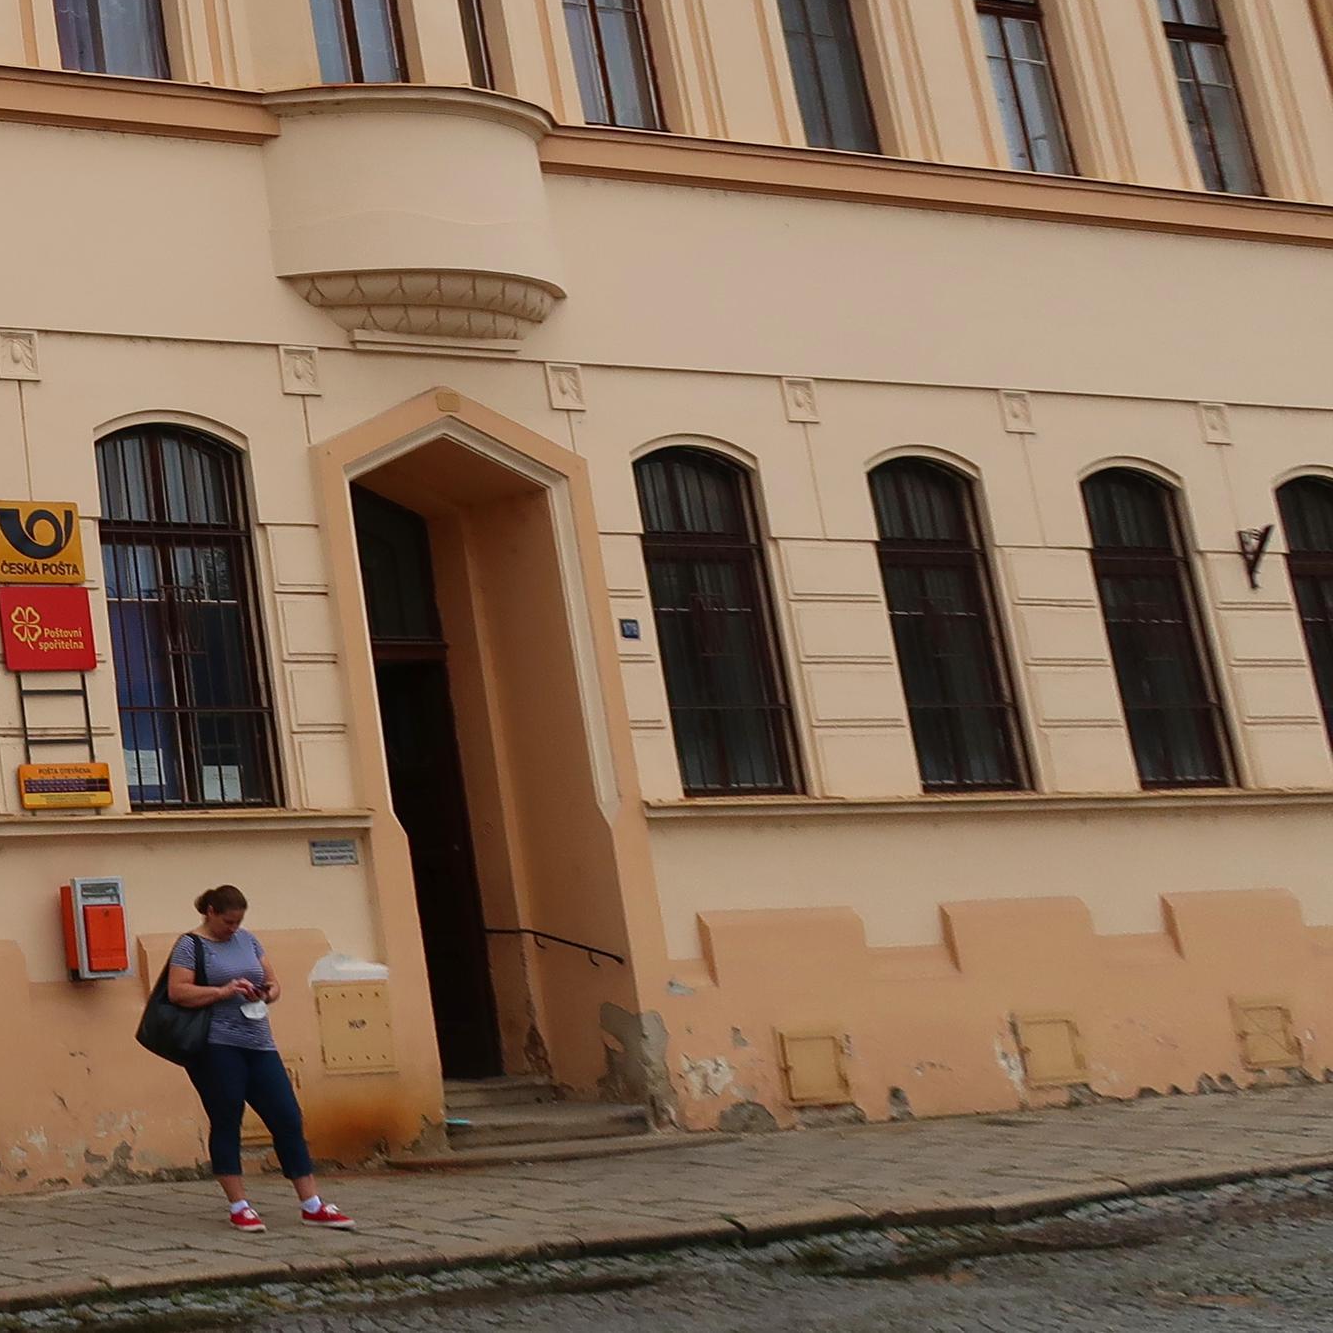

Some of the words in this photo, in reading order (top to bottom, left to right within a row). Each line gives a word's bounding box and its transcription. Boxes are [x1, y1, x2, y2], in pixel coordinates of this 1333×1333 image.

[0, 560, 40, 574] ČESKÁ
[42, 560, 80, 576] POŠTA
[43, 628, 83, 638] Poštovní
[38, 639, 85, 652] spořitelna
